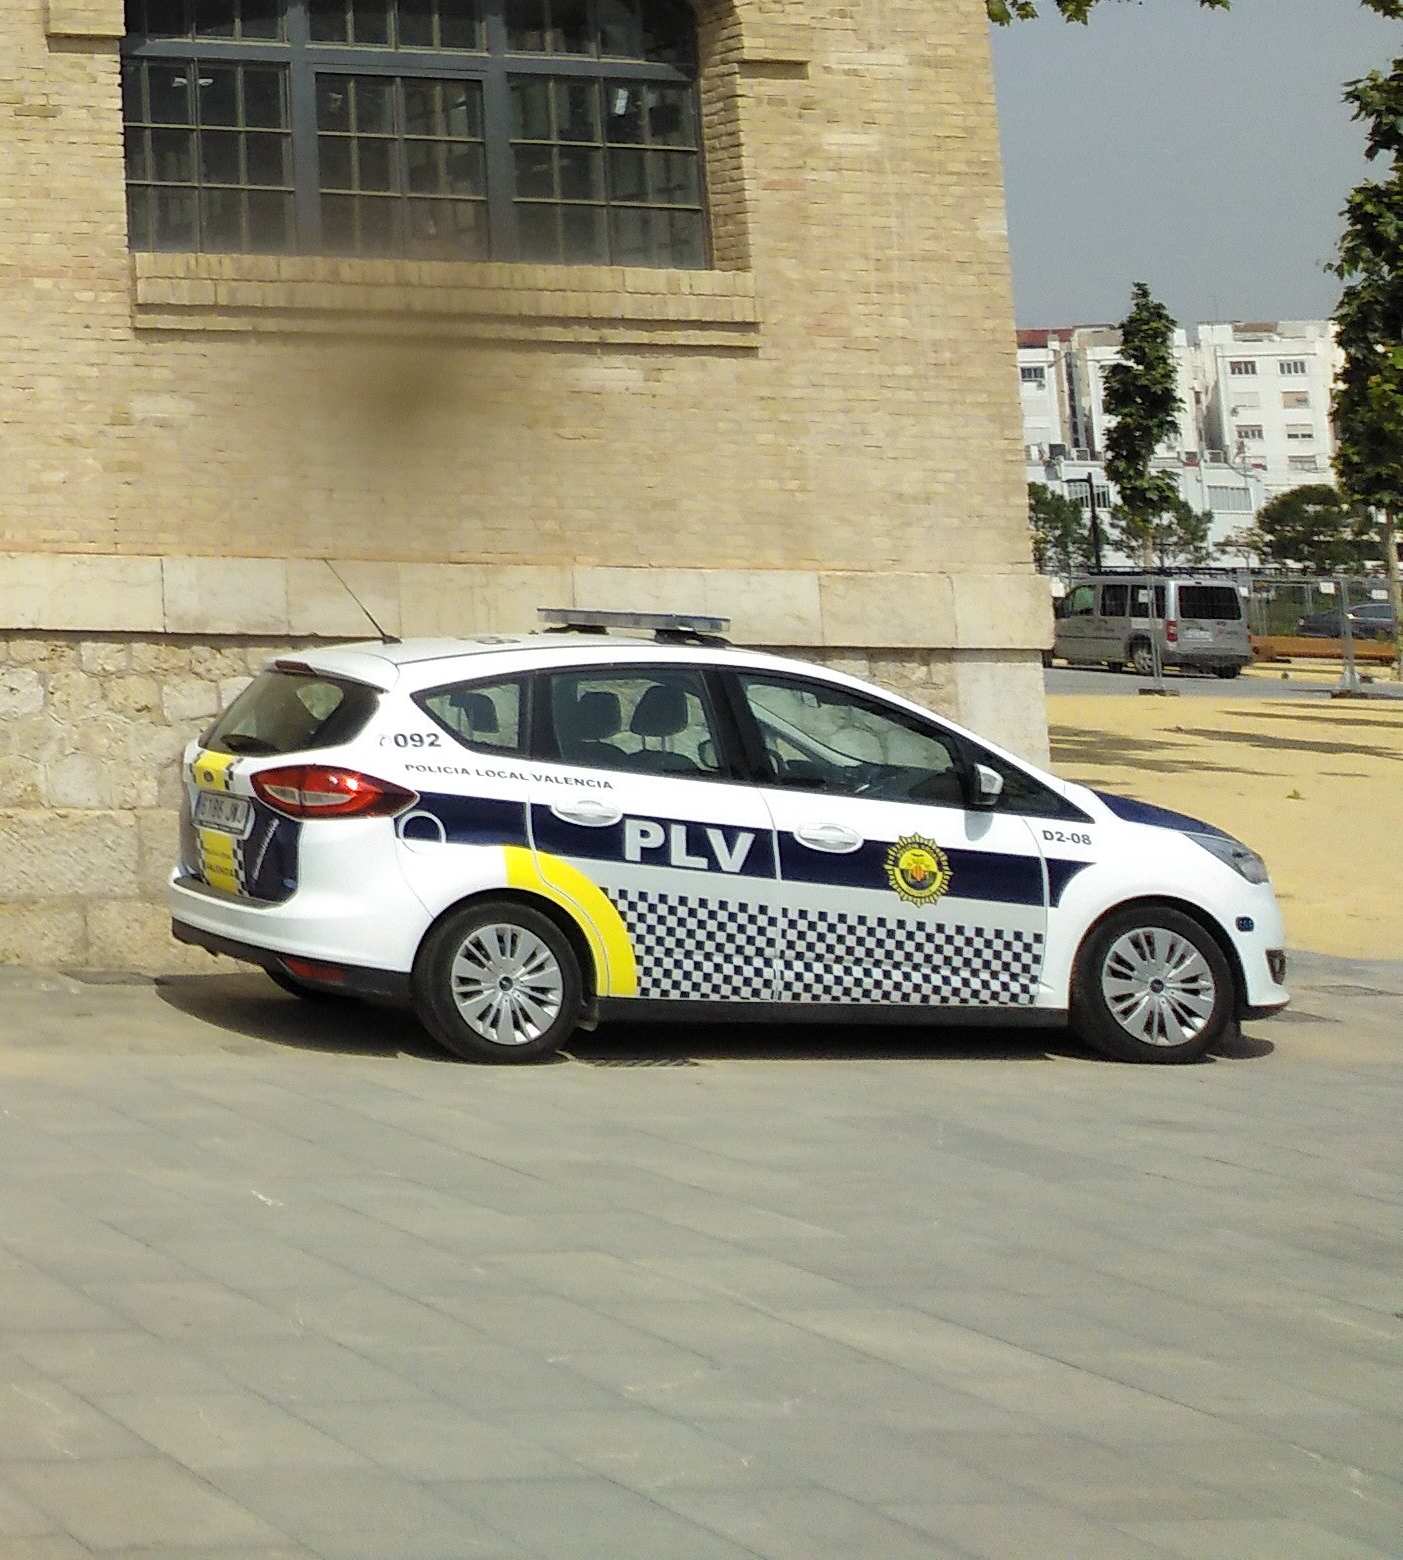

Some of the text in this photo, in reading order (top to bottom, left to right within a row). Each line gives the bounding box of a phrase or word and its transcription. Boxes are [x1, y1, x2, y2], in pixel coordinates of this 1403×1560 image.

[394, 733, 442, 748] 092
[405, 763, 614, 790] POLICIA LOCAL VALENCIA
[624, 818, 756, 873] PLV
[1041, 829, 1093, 846] D2-08
